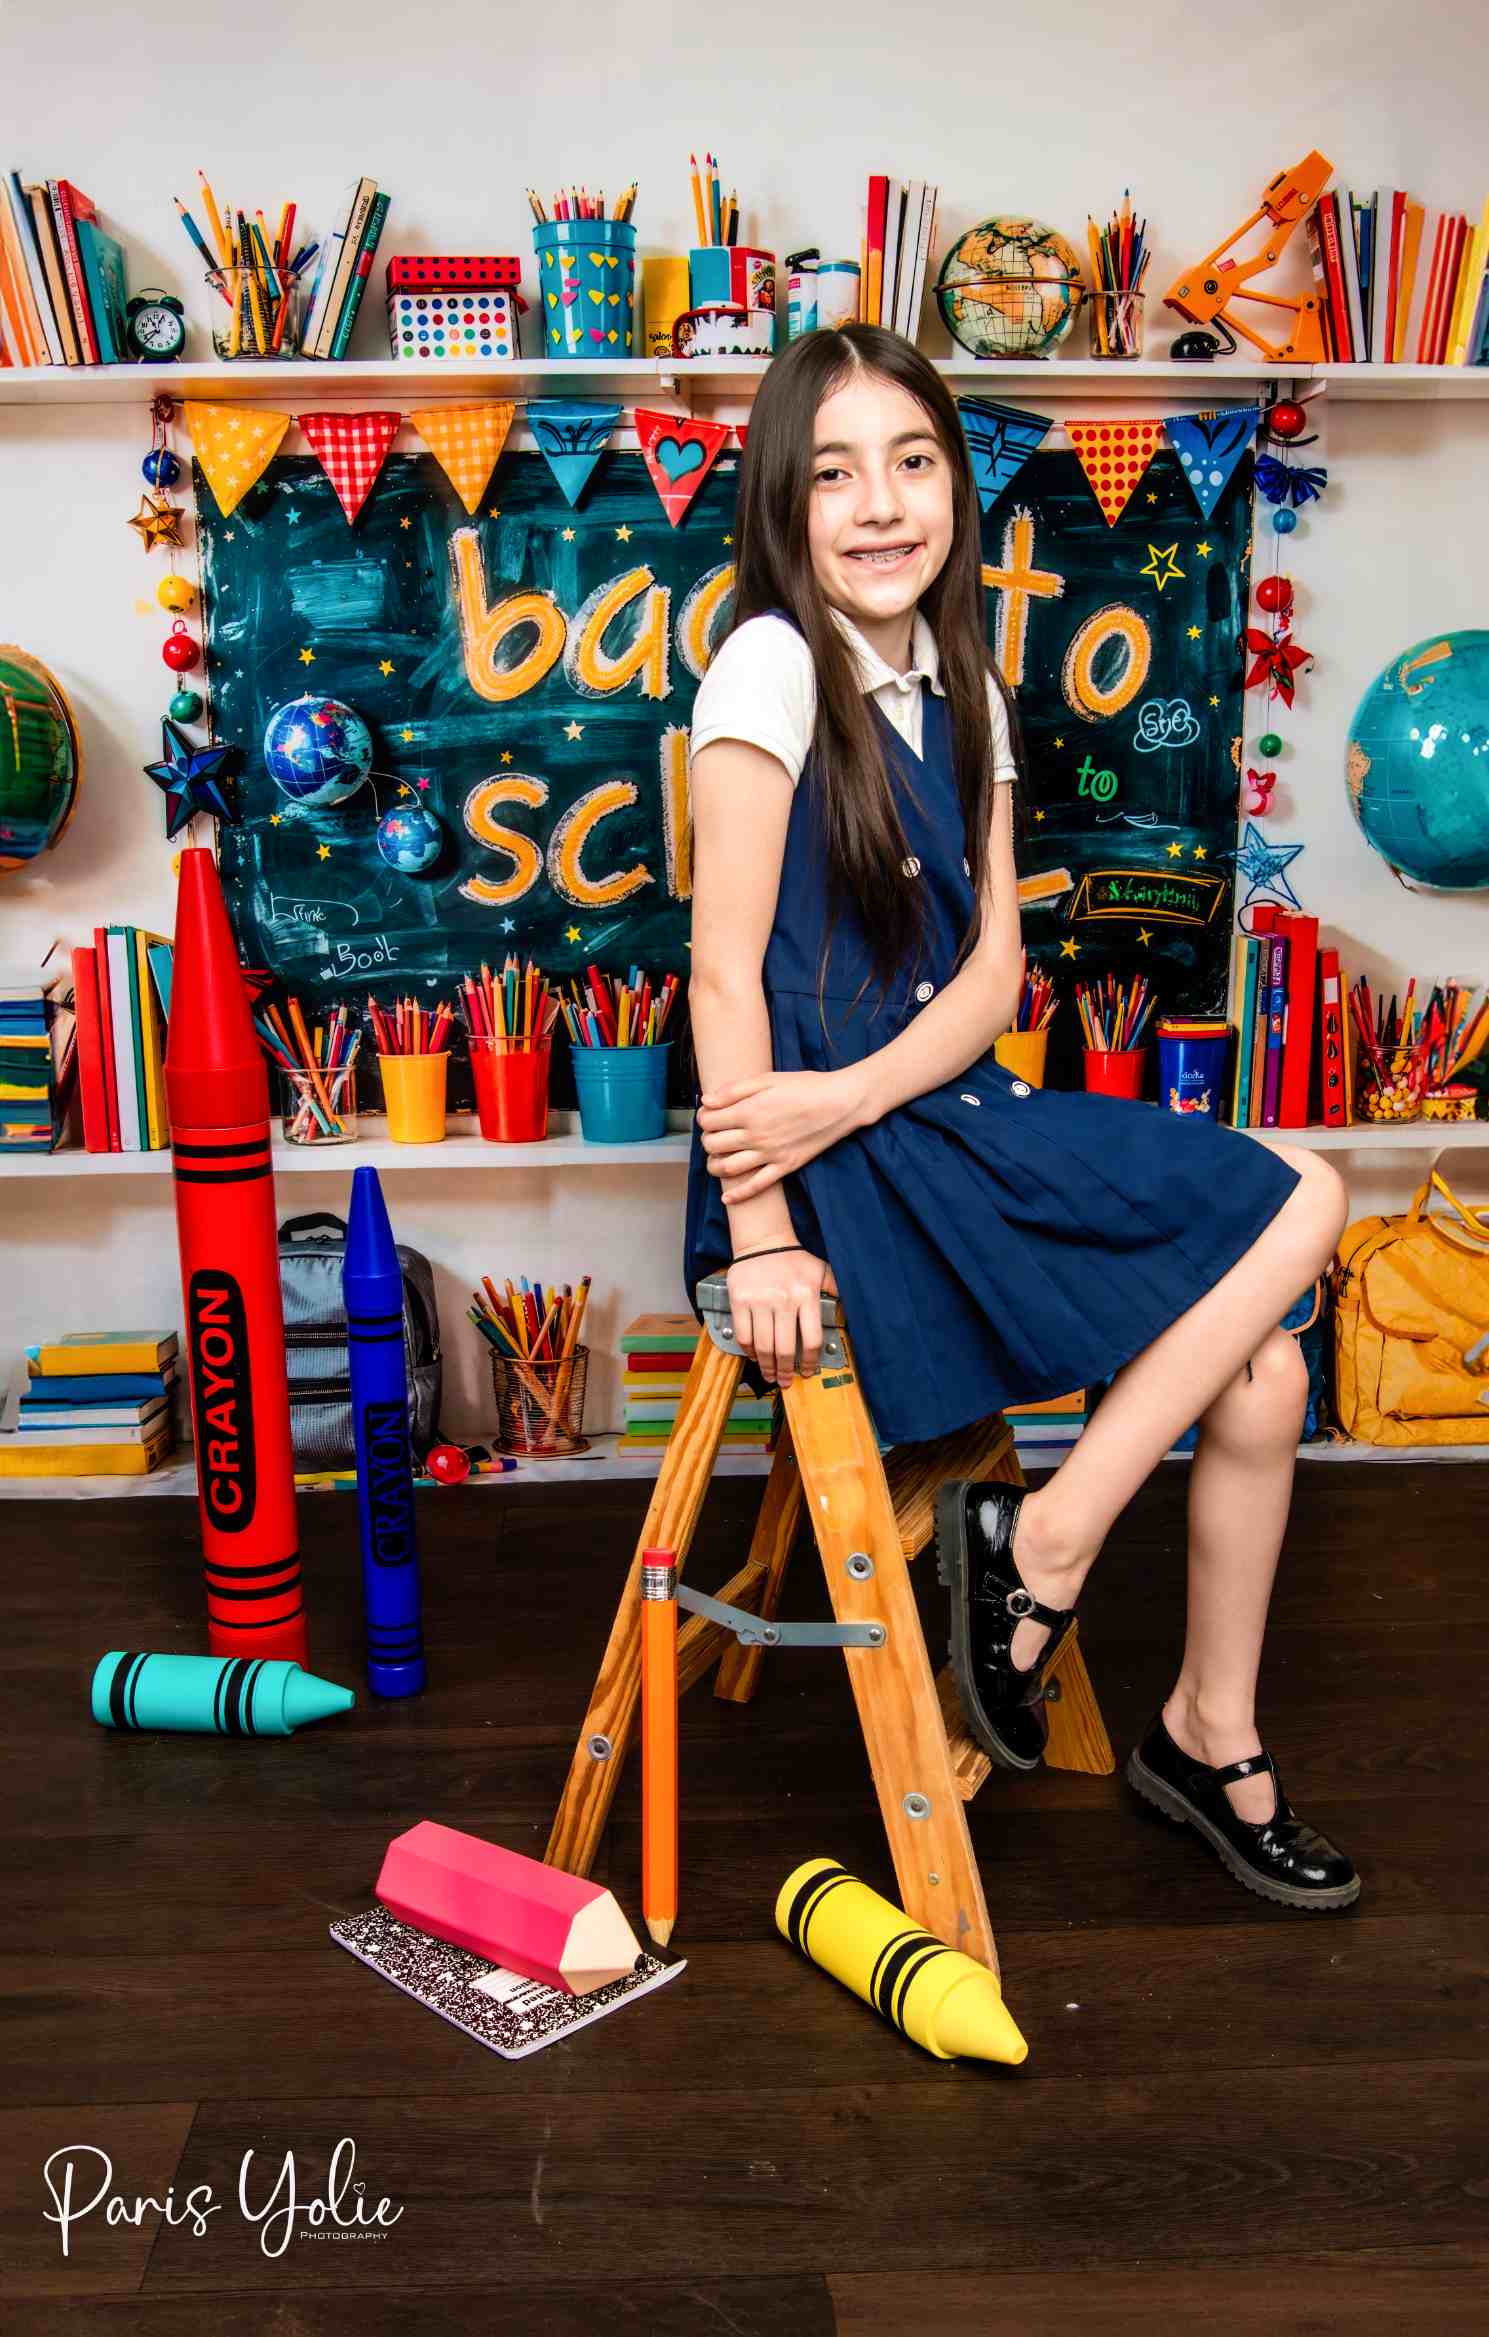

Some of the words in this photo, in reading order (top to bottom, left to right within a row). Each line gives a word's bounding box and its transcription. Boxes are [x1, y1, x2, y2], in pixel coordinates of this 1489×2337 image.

[981, 504, 1151, 724] to
[1077, 754, 1119, 802] to
[195, 1288, 244, 1516] CRAYON
[368, 1410, 411, 1563] CRAYON
